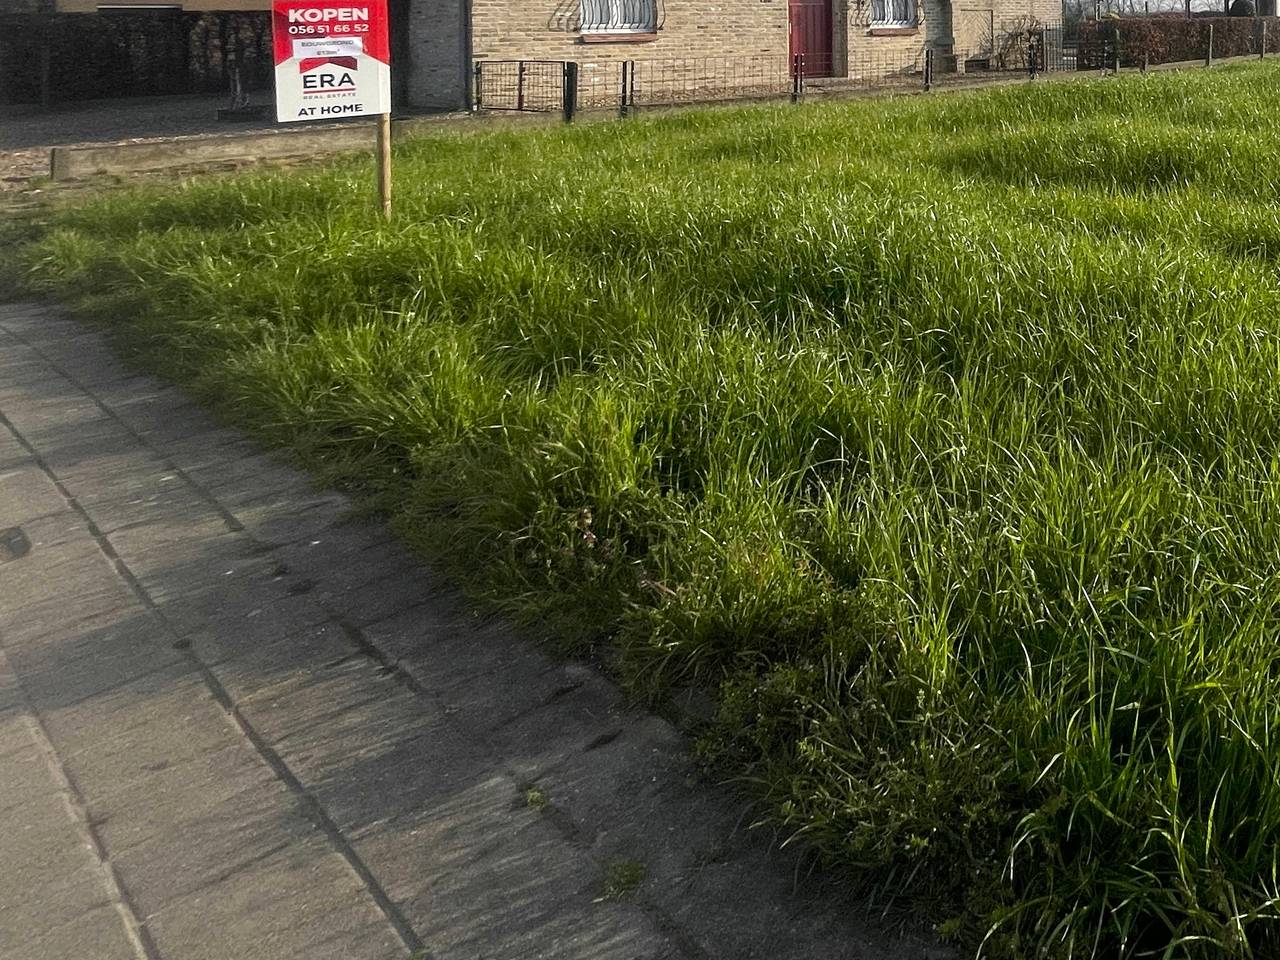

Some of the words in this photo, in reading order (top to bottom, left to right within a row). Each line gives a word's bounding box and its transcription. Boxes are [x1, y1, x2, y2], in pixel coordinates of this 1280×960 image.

[288, 7, 368, 22] KOPEN
[288, 25, 315, 34] 056
[317, 25, 329, 33] 51
[334, 24, 350, 32] 66
[354, 24, 368, 32] 52
[303, 72, 355, 88] ERA
[298, 107, 316, 116] AT
[321, 104, 363, 114] HOME
